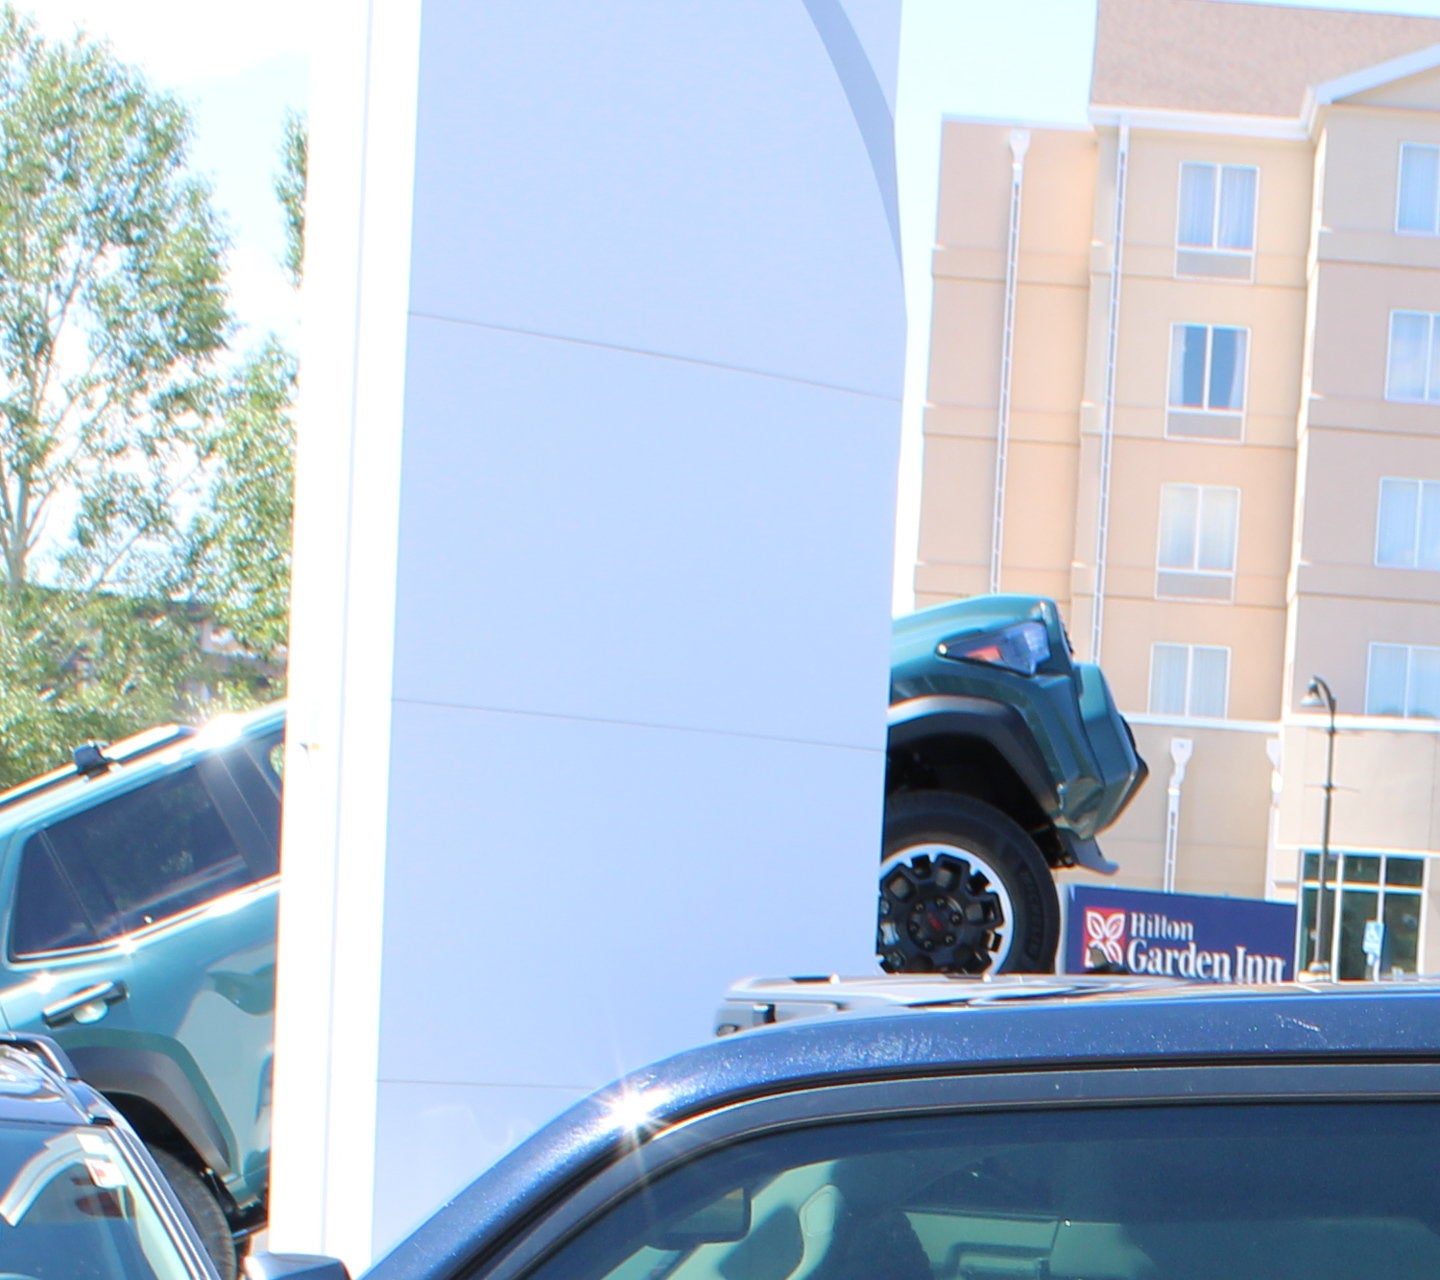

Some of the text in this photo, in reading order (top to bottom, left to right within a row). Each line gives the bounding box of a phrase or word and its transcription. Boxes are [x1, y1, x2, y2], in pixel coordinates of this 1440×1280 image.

[1130, 911, 1194, 942] Hilton
[1127, 940, 1286, 984] Garden Inn
